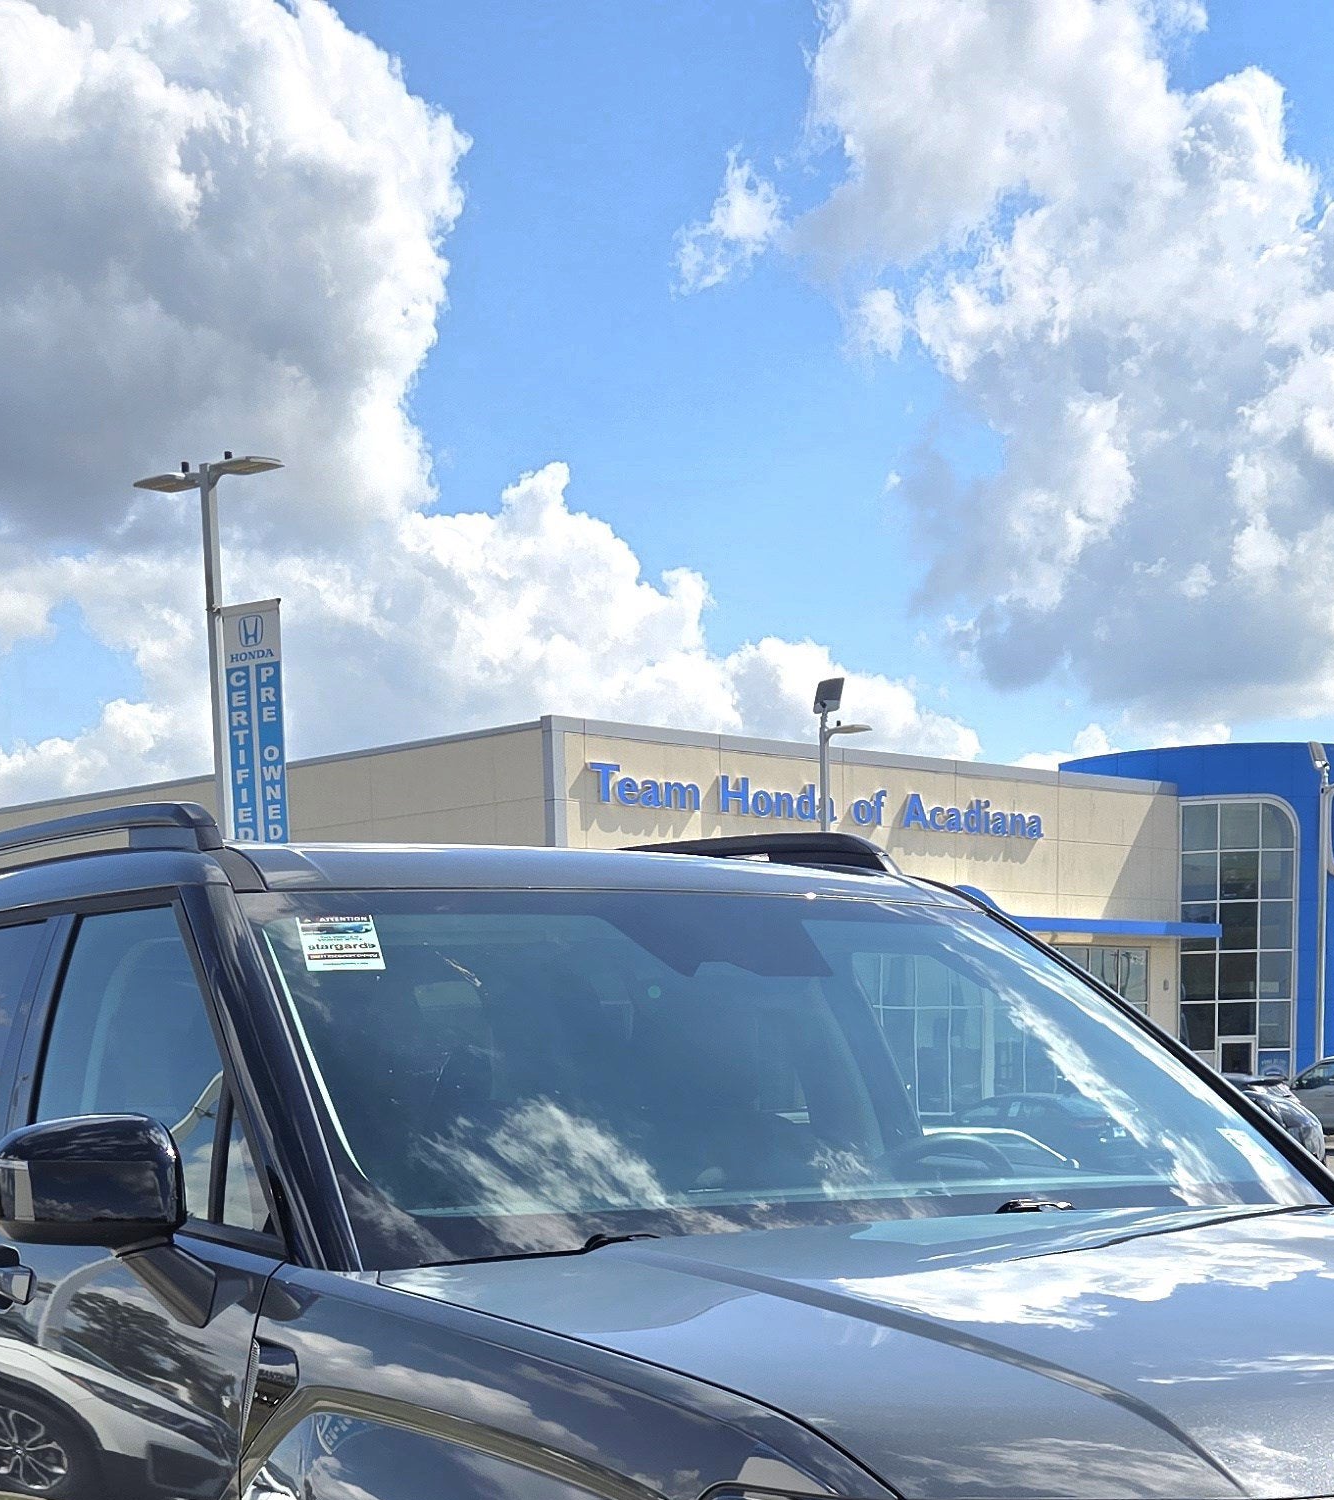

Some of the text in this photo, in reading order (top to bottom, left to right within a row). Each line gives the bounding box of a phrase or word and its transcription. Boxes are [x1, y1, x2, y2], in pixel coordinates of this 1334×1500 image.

[229, 648, 275, 663] HONDA
[229, 670, 255, 841] CERTIFIED
[260, 667, 283, 841] PRE OWNED
[589, 762, 701, 812] Team
[853, 789, 889, 826] of
[903, 793, 1045, 840] Acadiana
